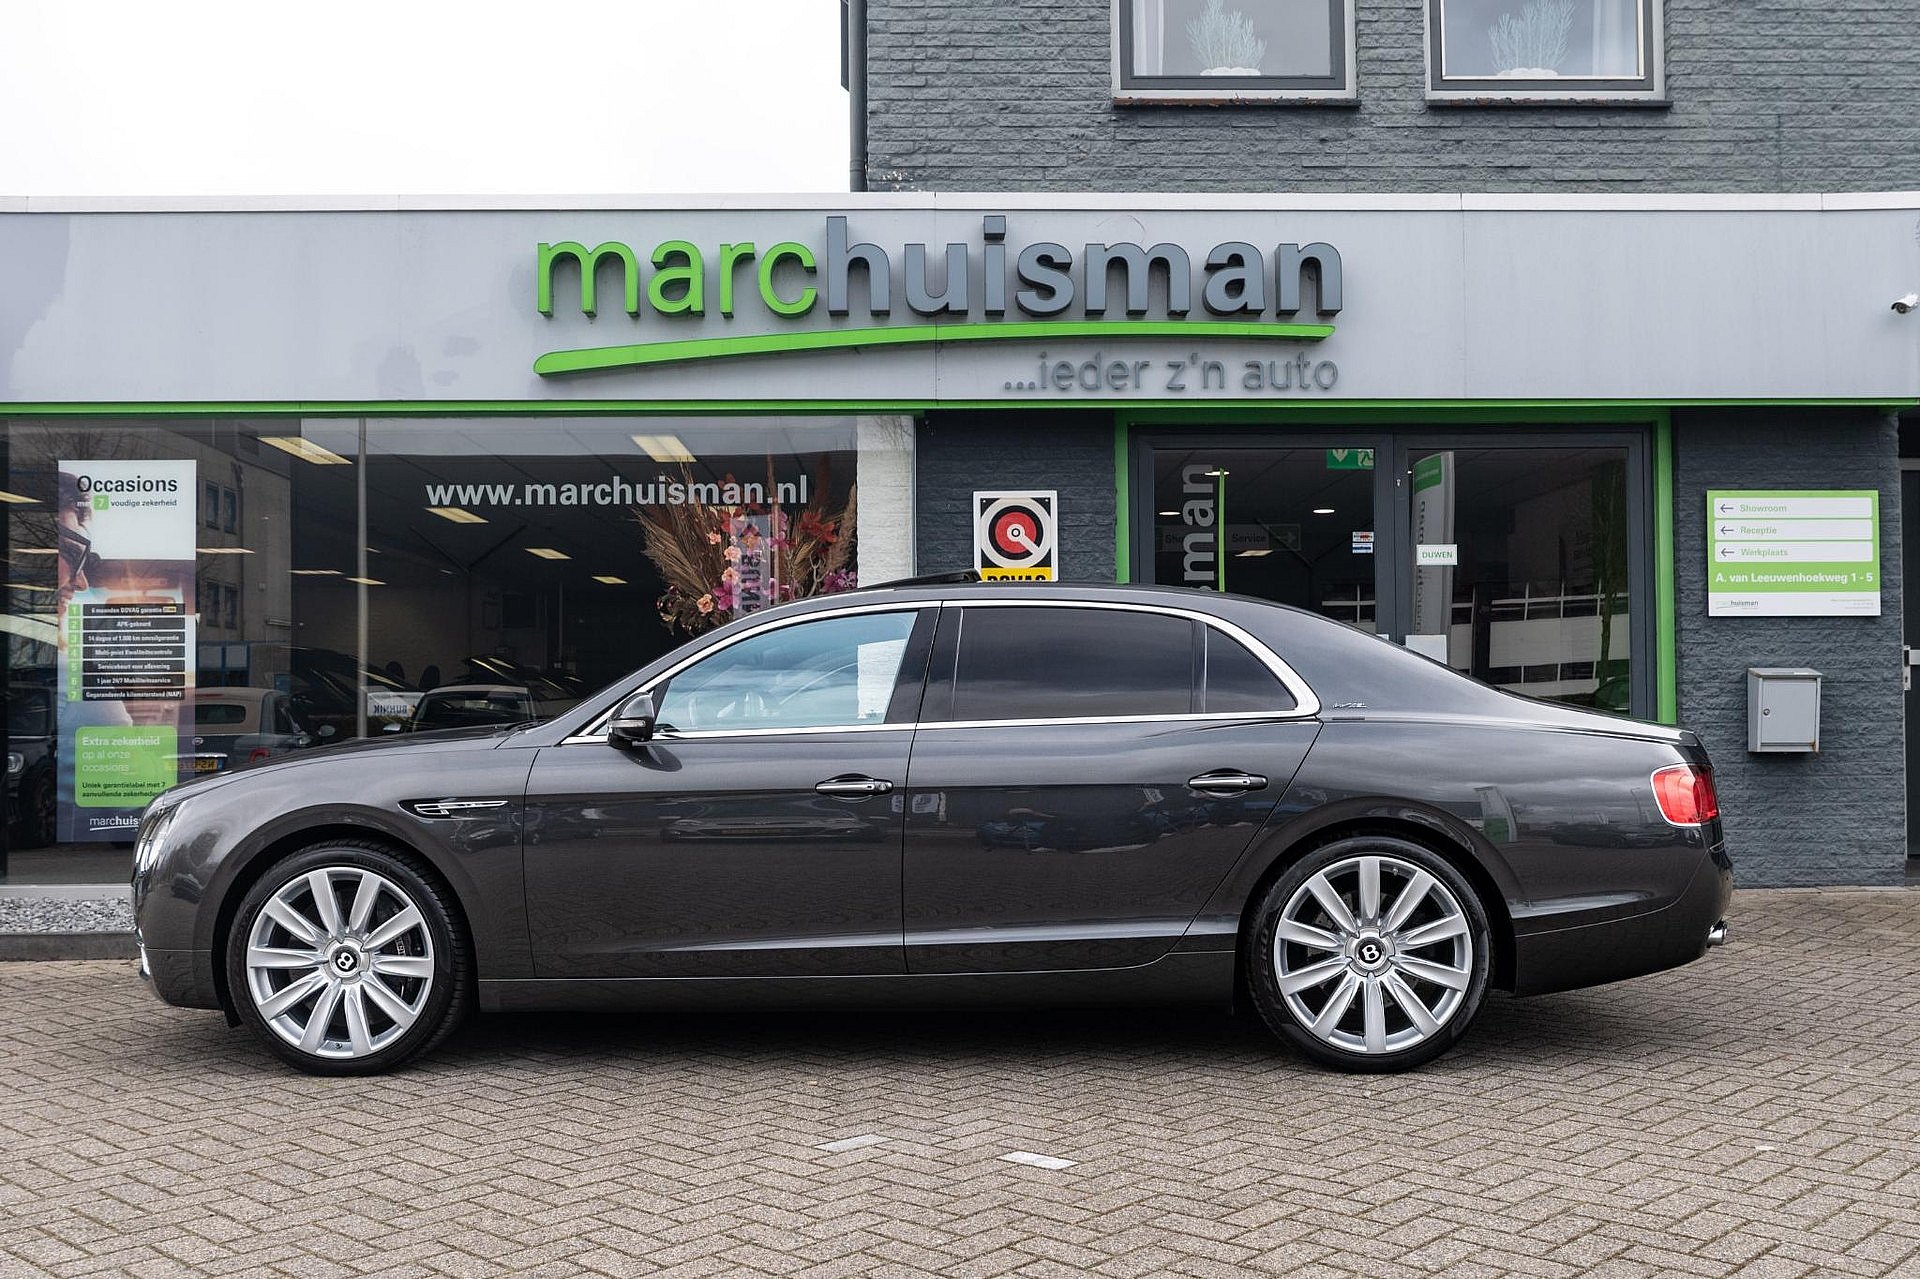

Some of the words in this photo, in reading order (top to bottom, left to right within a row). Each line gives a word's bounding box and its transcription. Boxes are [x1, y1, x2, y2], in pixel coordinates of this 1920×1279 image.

[536, 216, 1344, 319] marchuisman
[1004, 352, 1150, 390] ...ieder
[1166, 352, 1226, 390] z'n
[1243, 352, 1339, 390] auto
[77, 475, 178, 492] Occasions
[425, 475, 808, 506] www.marchuisman.nl
[110, 499, 140, 508] voudige
[142, 499, 178, 507] zekerheid
[1739, 504, 1788, 513] Showroom
[1182, 464, 1215, 591] man
[1740, 526, 1778, 536] Receptie
[1231, 534, 1267, 544] Service
[1421, 551, 1453, 559] DUWEN
[1740, 547, 1789, 558] Werkplaats
[1715, 573, 1727, 583] A.
[1730, 575, 1748, 583] van
[1751, 572, 1848, 585] Leeuwenhoekweg
[1850, 573, 1857, 583] 1
[1866, 573, 1873, 583] 5
[82, 737, 110, 746] Extra
[111, 736, 160, 746] zekerheid
[82, 751, 95, 760] op
[96, 750, 105, 759] al
[107, 751, 130, 759] onze
[82, 764, 129, 772] occasions
[102, 782, 146, 790] garantielabel
